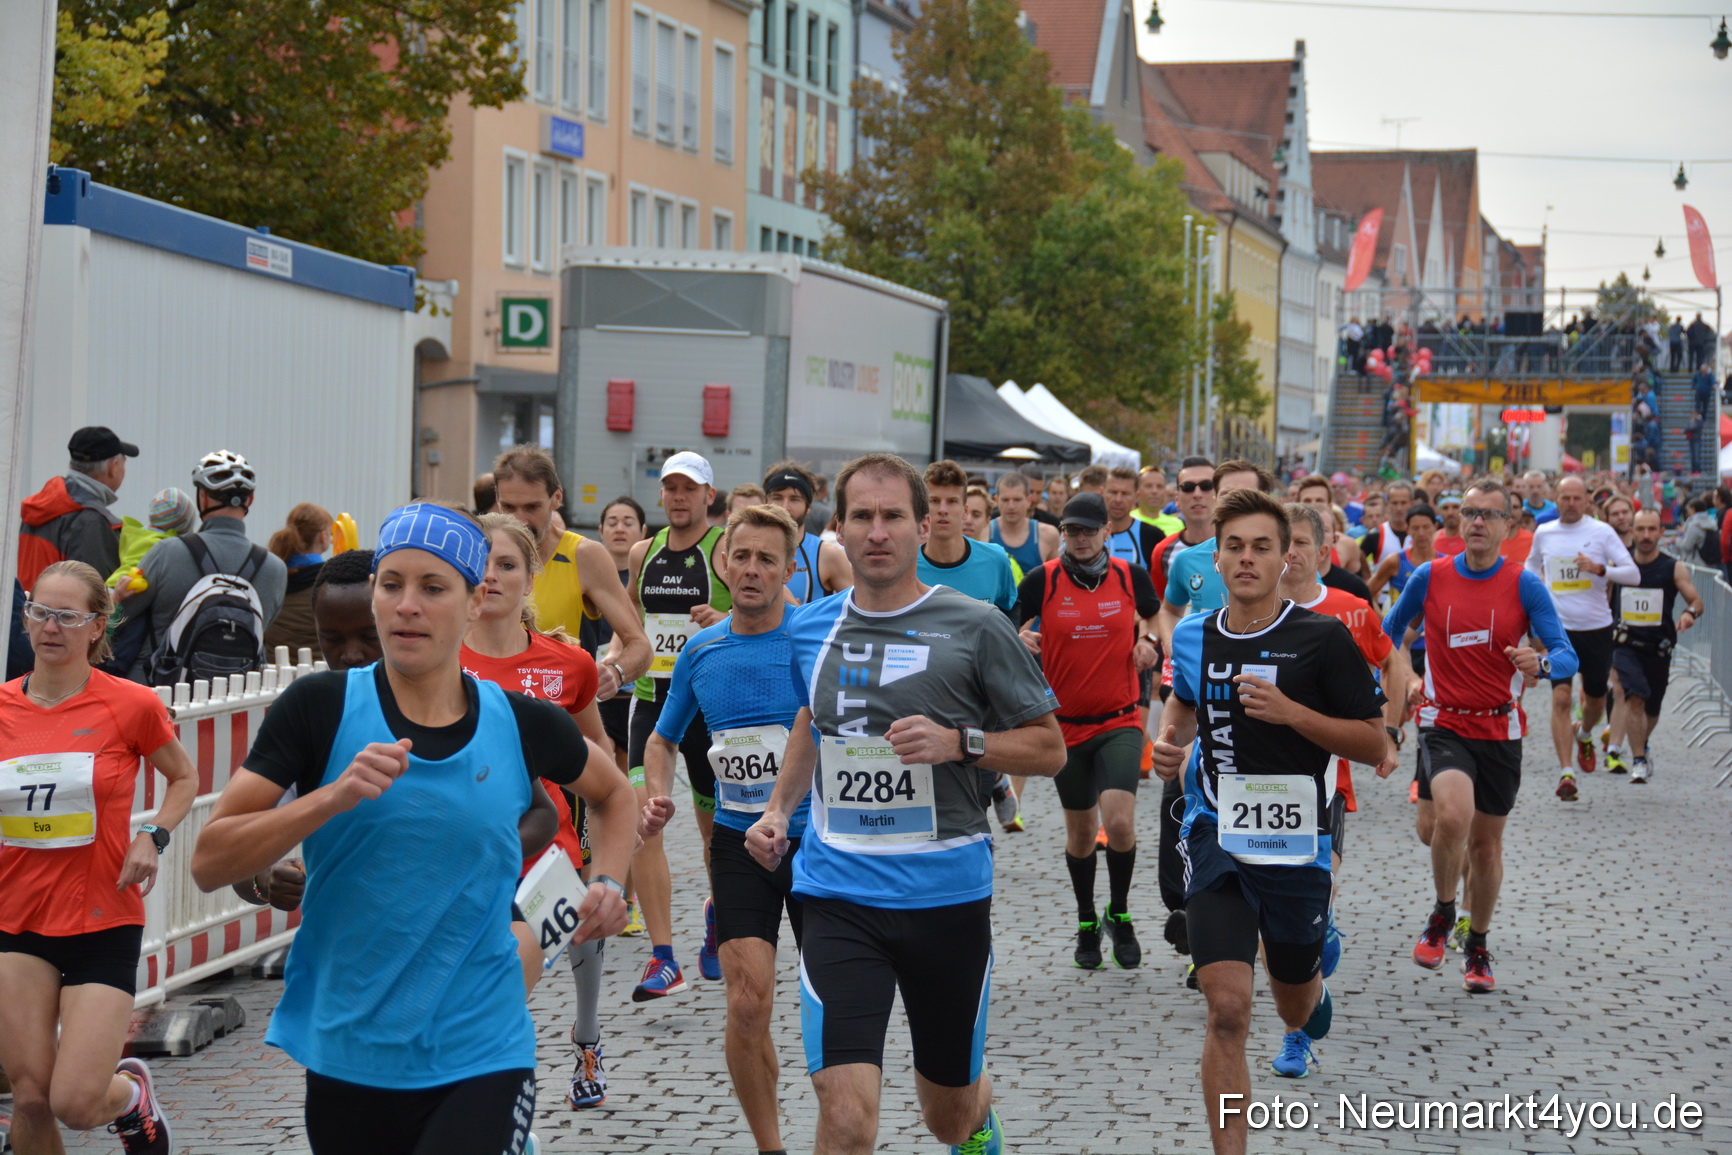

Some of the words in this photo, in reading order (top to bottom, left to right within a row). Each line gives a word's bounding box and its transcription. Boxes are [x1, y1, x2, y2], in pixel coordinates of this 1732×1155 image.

[508, 303, 545, 342] D
[1560, 568, 1580, 579] 187
[662, 575, 682, 584] DAV
[644, 586, 700, 596] Röthenbach
[1634, 600, 1649, 611] 10
[532, 667, 563, 675] Wolfstein
[857, 747, 896, 756] BOCK
[26, 762, 62, 772] BOCK
[719, 752, 779, 781] 2364
[837, 770, 916, 803] 2284
[20, 783, 57, 811] 77
[859, 814, 895, 826] Martin
[1232, 802, 1302, 830] 2135
[33, 822, 51, 832] Eva
[1247, 839, 1288, 849] Dominik
[540, 897, 580, 950] 46
